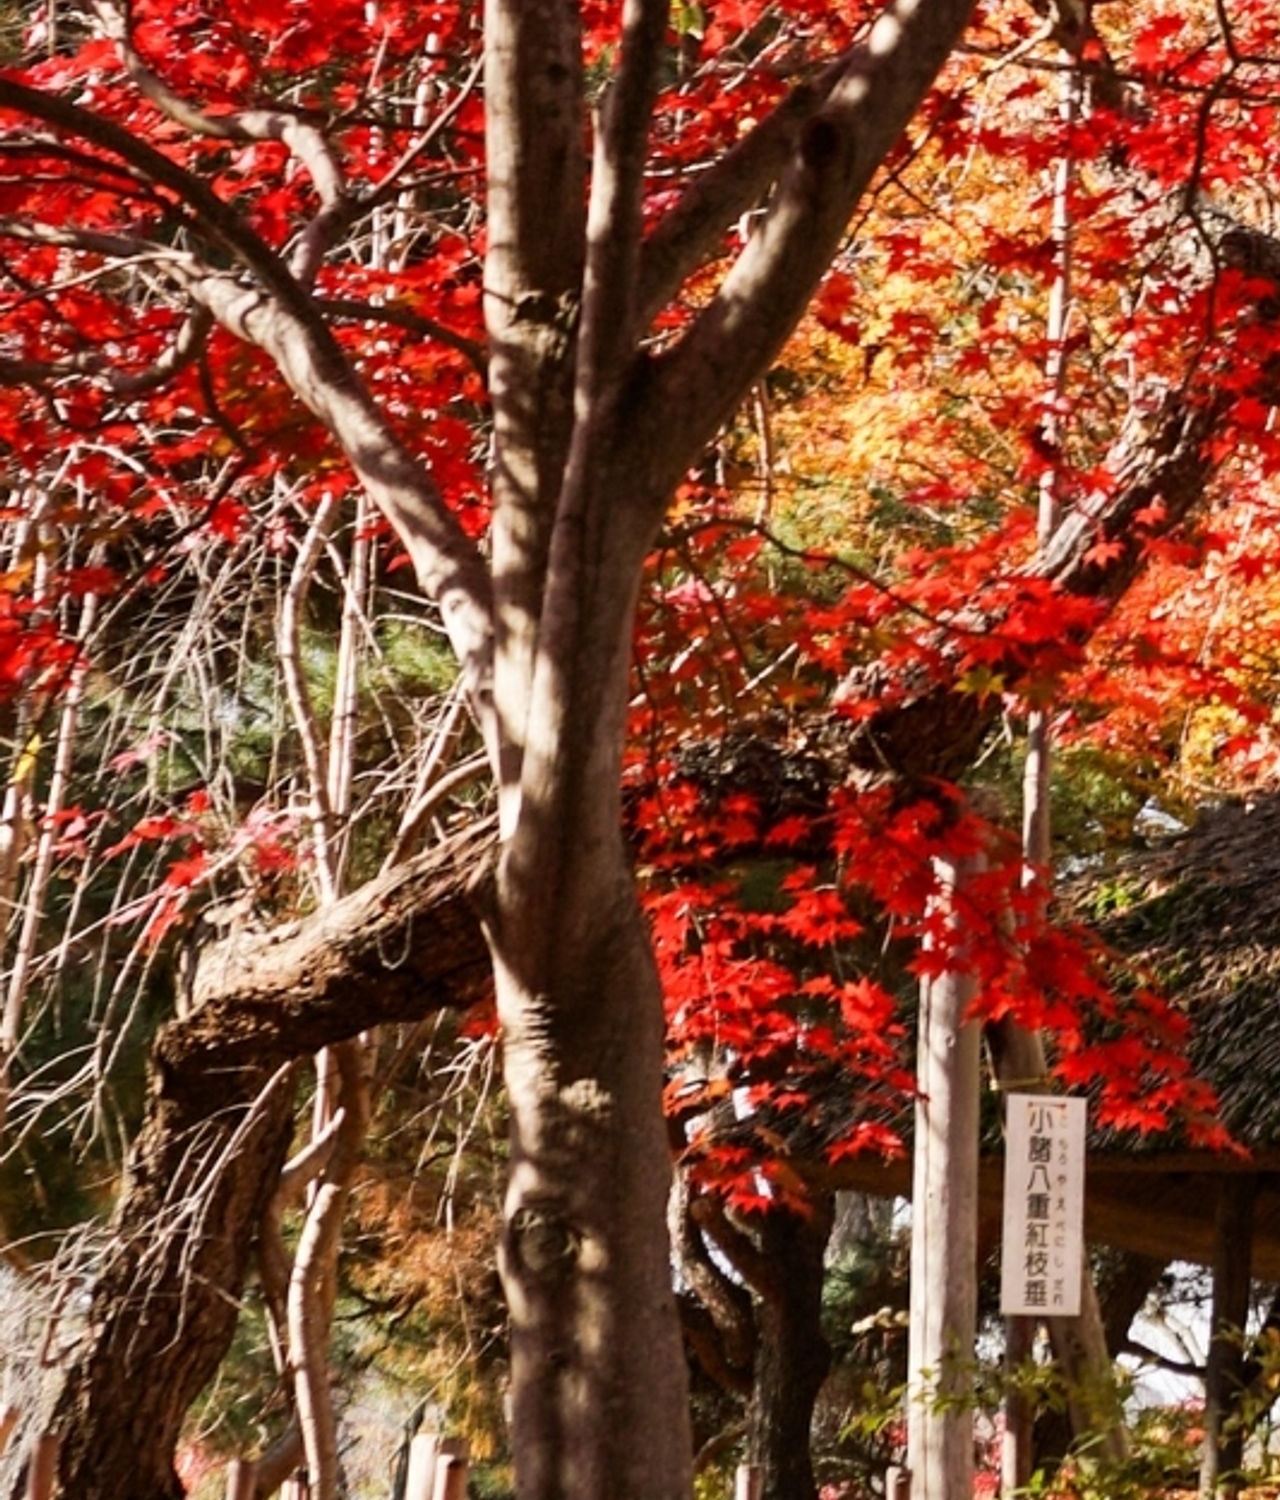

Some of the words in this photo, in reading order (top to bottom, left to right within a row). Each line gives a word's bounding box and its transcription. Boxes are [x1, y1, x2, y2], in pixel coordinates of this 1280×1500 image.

[1023, 1107, 1053, 1307] 小諸八重紅枝垂
